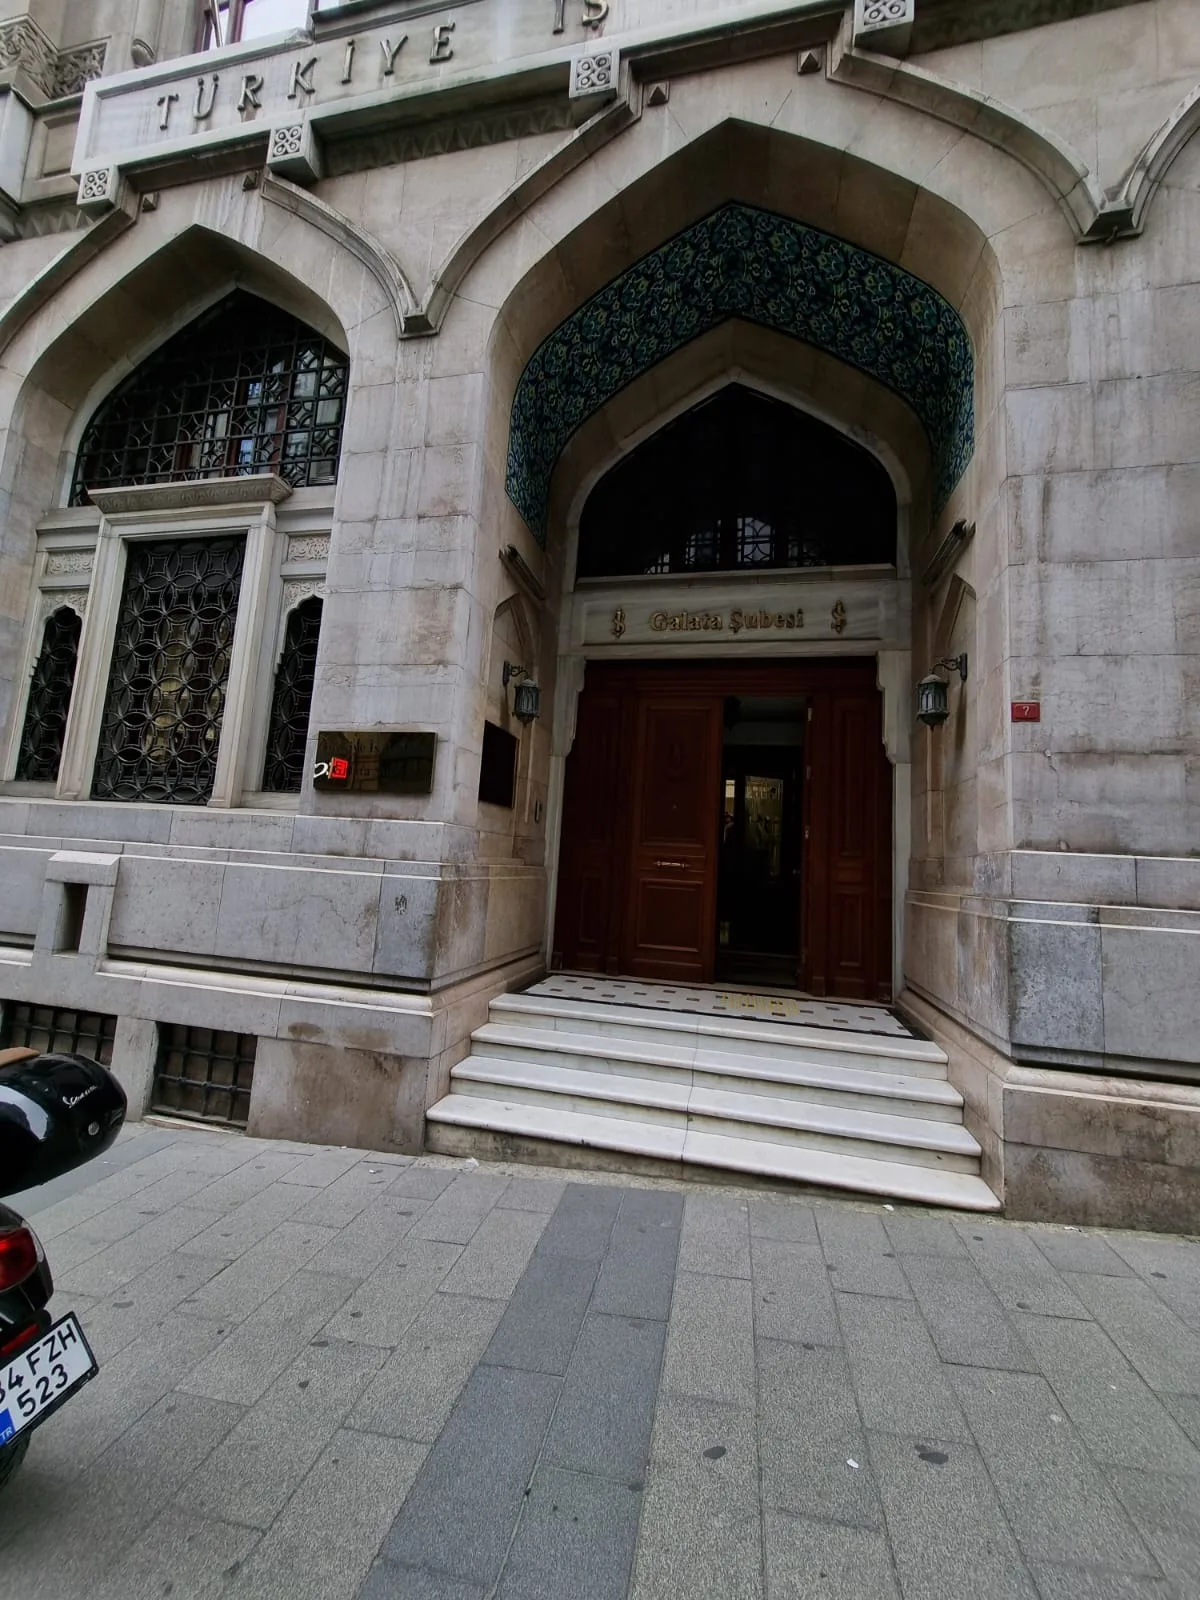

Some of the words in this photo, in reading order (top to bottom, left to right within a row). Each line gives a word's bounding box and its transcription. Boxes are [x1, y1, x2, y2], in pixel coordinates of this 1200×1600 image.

[156, 19, 456, 131] TÜRKİYE
[650, 608, 723, 632] Galata
[728, 607, 805, 635] Şubesi
[25, 1323, 77, 1377] FZH
[16, 1363, 69, 1418] 523
